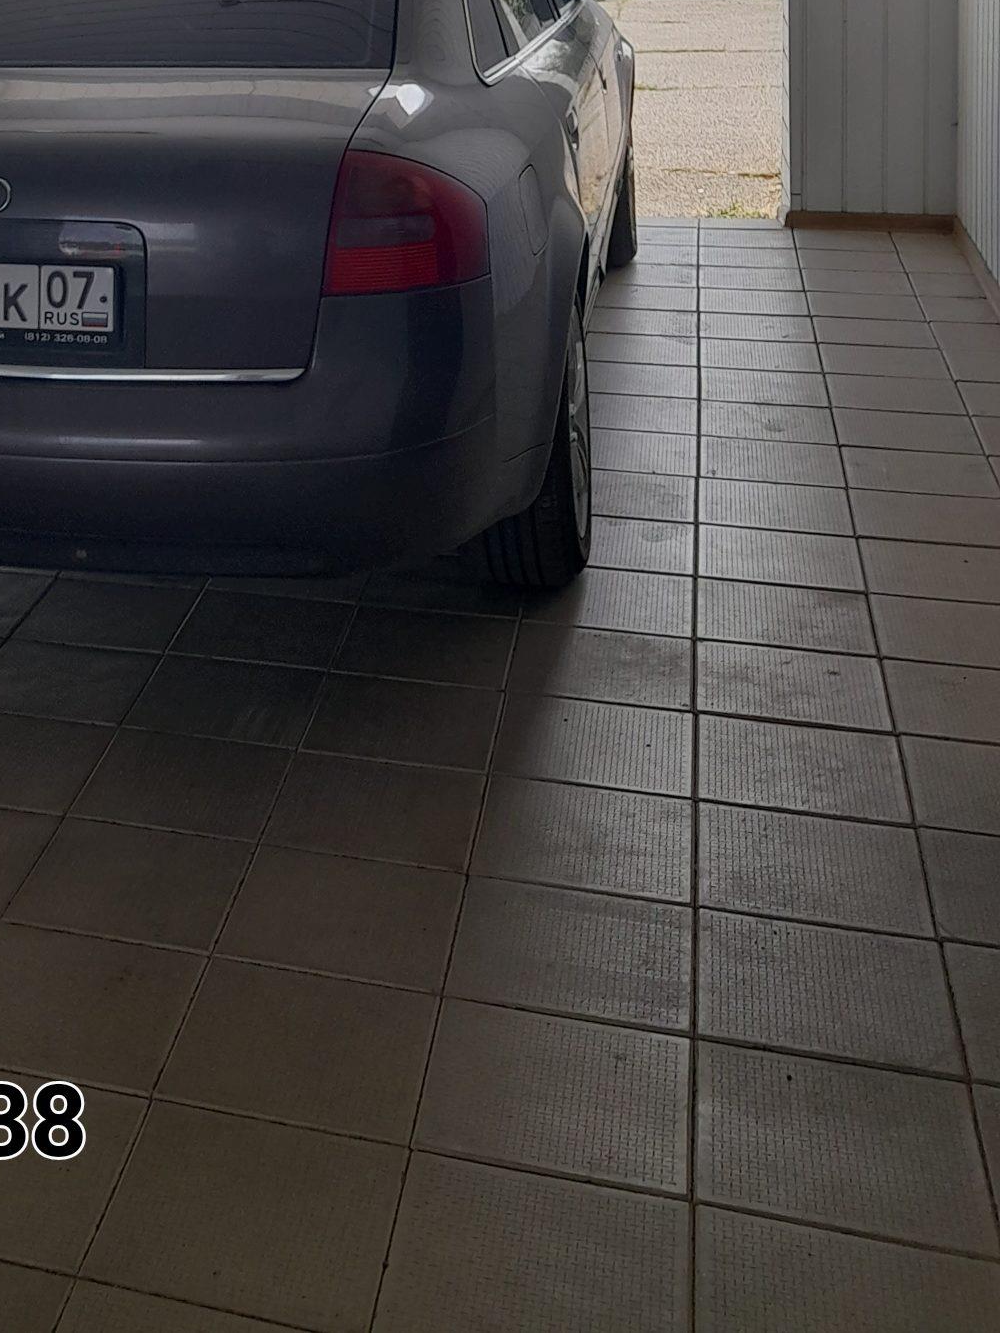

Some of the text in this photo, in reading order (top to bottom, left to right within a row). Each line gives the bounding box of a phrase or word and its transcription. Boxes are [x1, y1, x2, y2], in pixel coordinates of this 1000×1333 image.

[46, 271, 95, 310] 07
[44, 311, 80, 326] RUS
[24, 331, 51, 342] (812)
